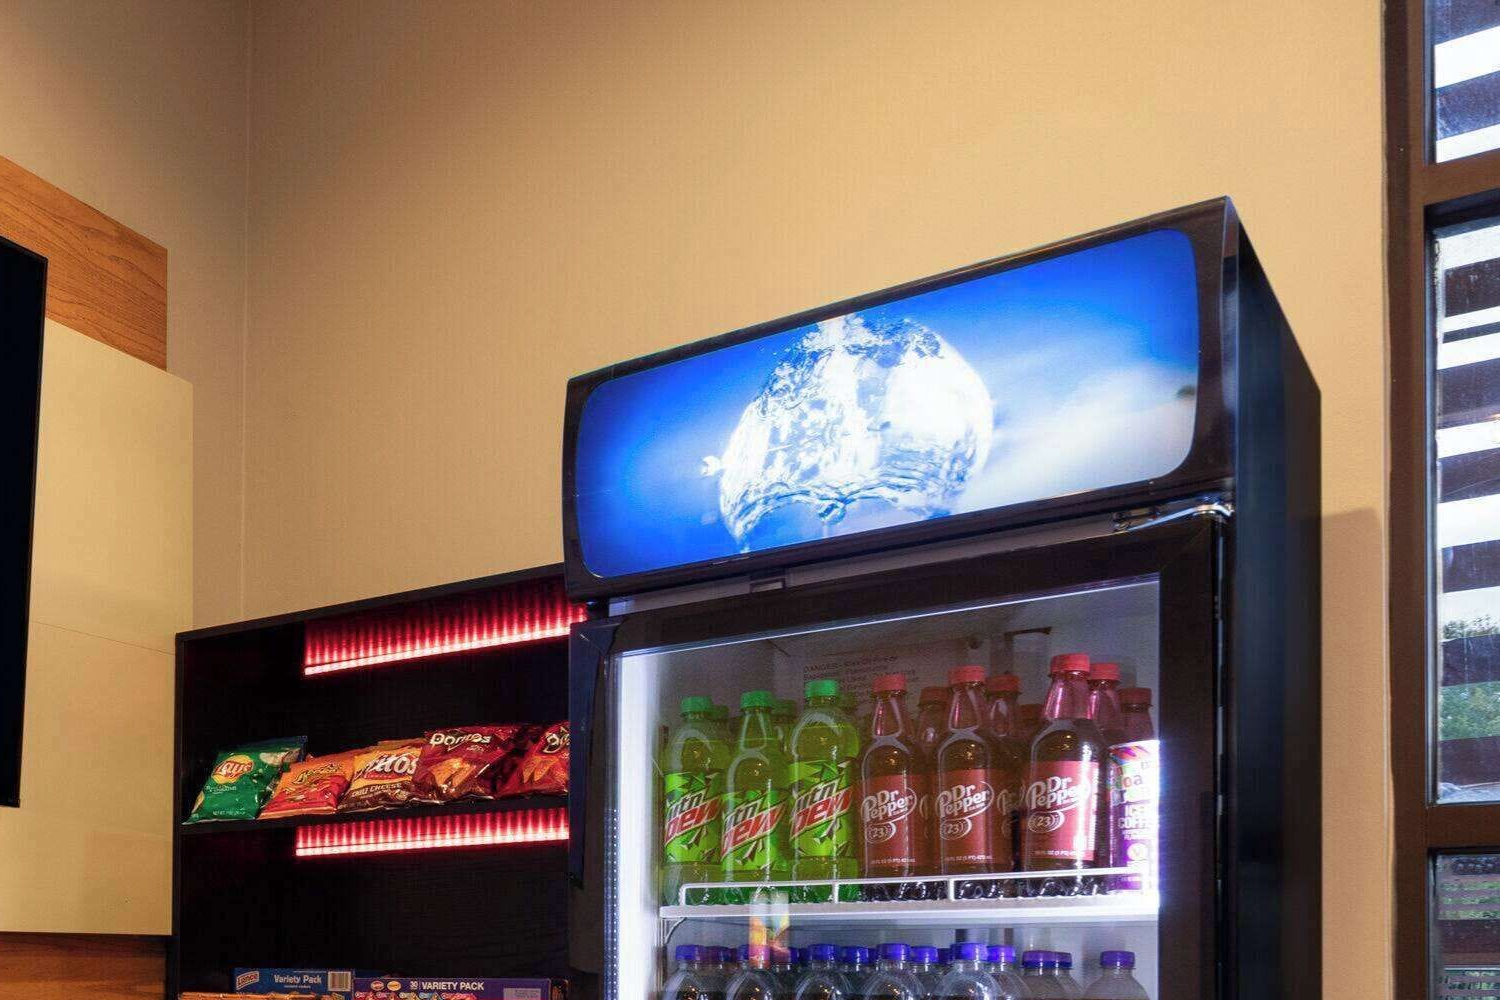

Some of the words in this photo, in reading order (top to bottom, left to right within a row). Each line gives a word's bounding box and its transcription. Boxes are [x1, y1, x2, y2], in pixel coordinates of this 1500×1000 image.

[430, 733, 492, 749] Doritos
[1046, 776, 1073, 792] Dr
[876, 790, 899, 806] Dr
[951, 784, 976, 802] Dr
[861, 795, 914, 822] Pepper
[936, 790, 990, 818] Pepper
[273, 974, 300, 985] Variety
[302, 974, 322, 984] Pack
[422, 981, 459, 990] VARIETY
[460, 981, 485, 991] PACK
